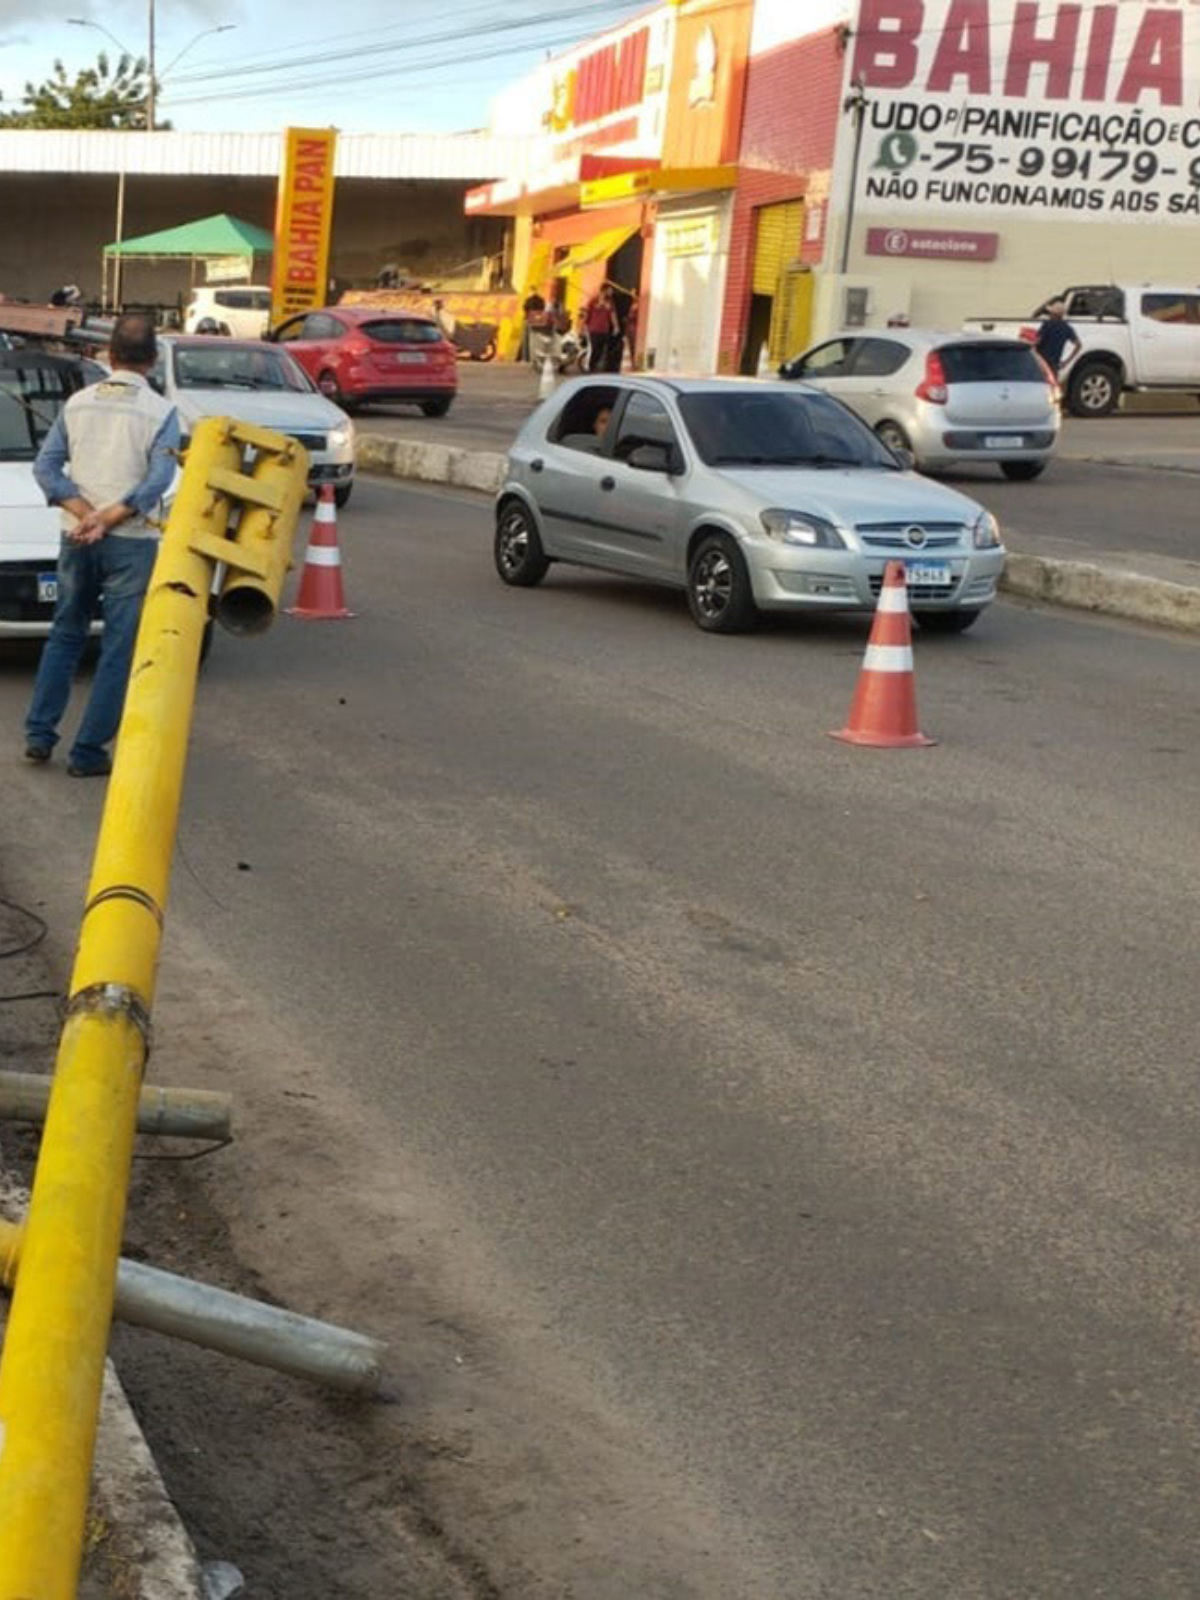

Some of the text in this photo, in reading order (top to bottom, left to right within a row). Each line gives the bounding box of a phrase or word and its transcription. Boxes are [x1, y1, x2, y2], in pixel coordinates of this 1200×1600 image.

[851, 0, 1183, 107] BAHIA
[850, 101, 942, 133] UDO
[962, 107, 1167, 151] PANIFICAÇÃO
[293, 139, 328, 193] PAN
[865, 170, 919, 201] NÃO
[925, 180, 1105, 210] FUNCIONAMOS
[1110, 190, 1160, 212] AOS
[286, 201, 323, 282] BAHIA
